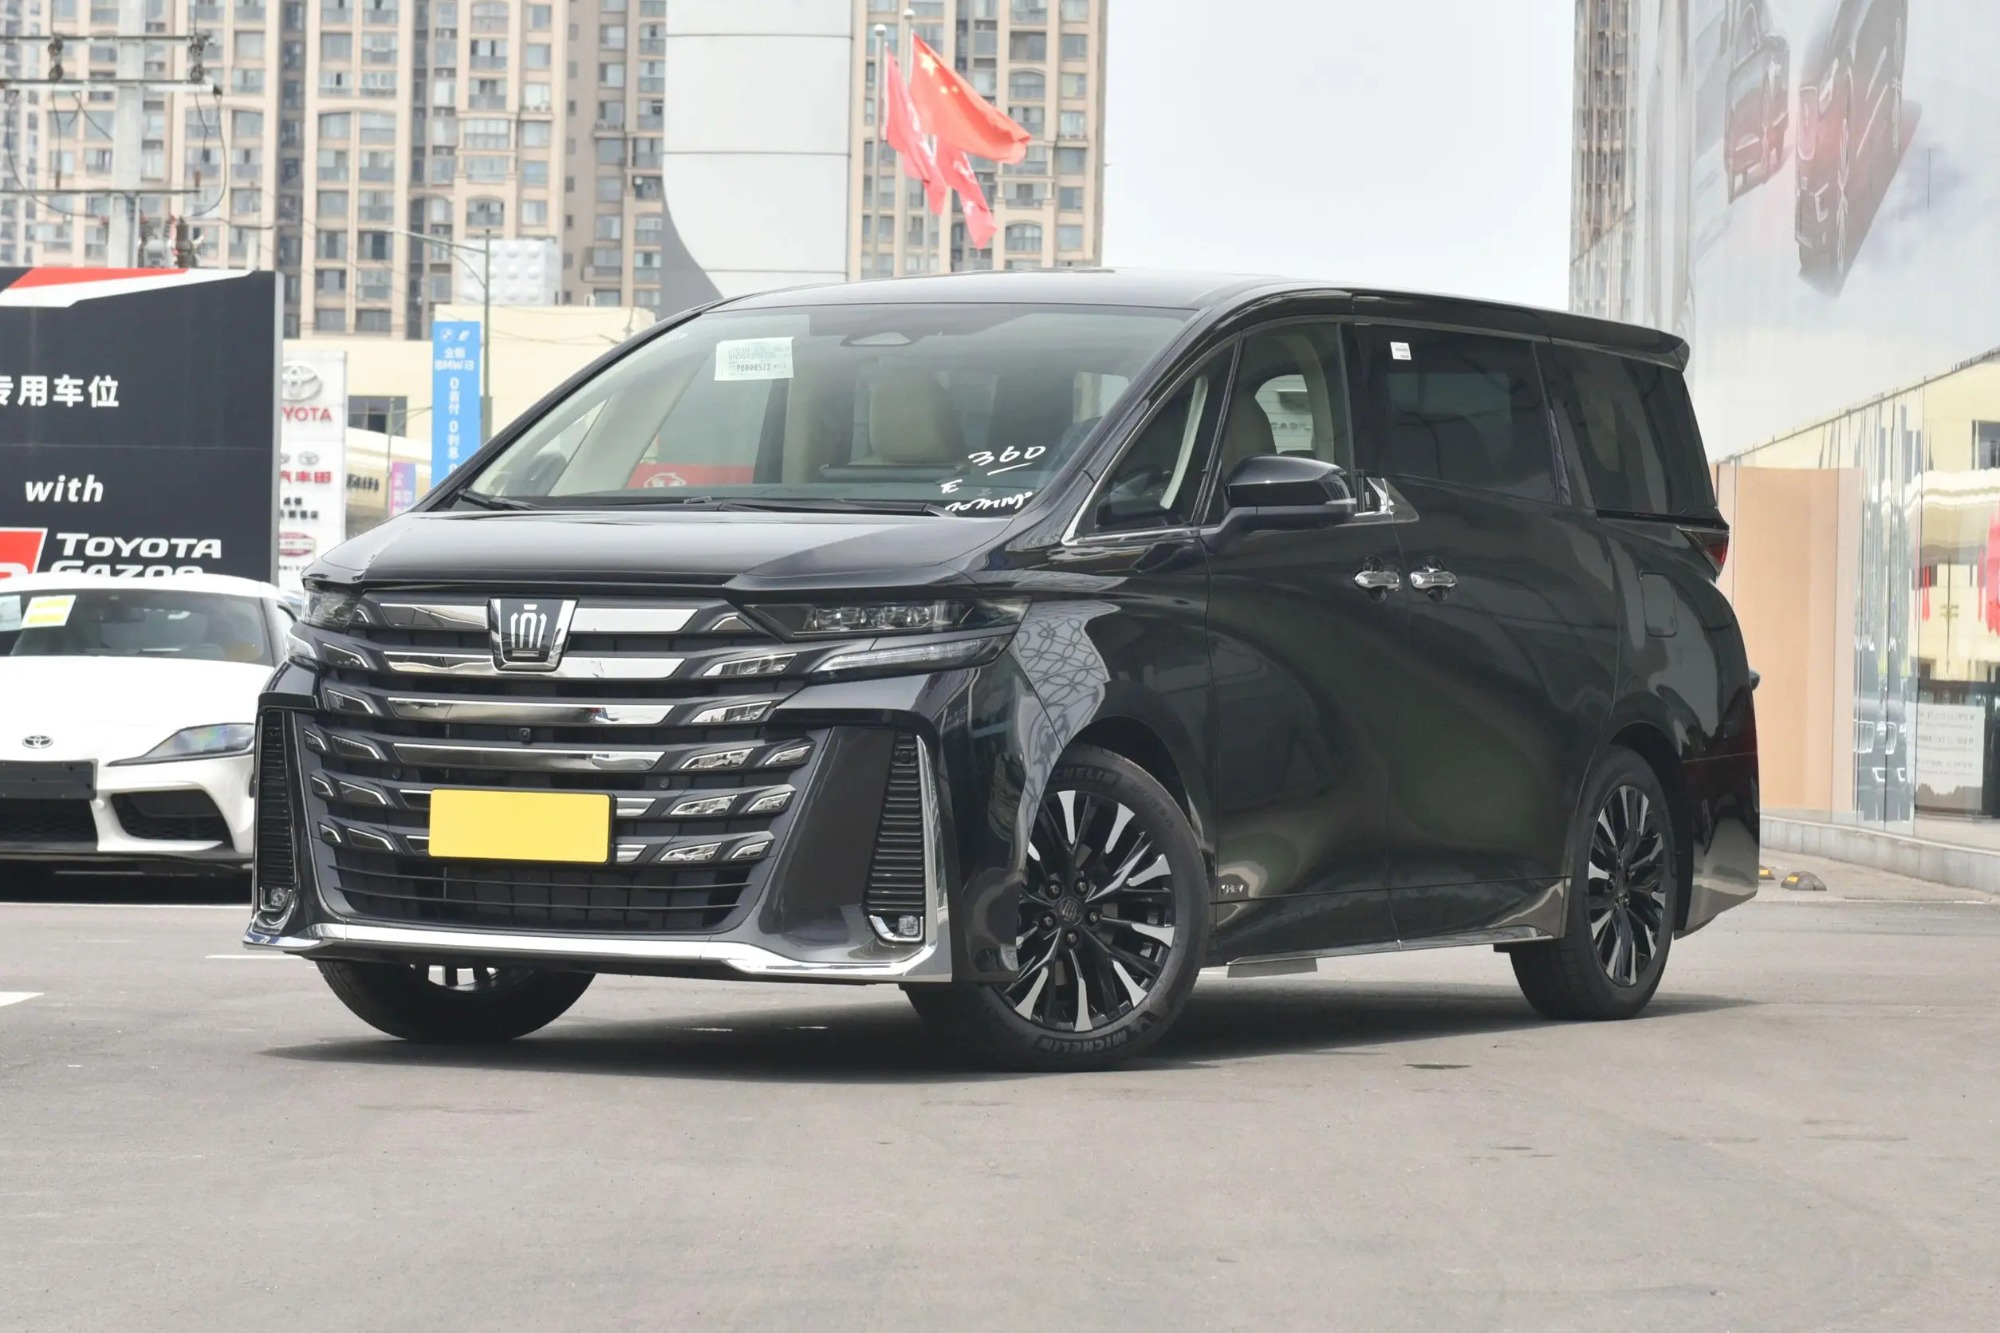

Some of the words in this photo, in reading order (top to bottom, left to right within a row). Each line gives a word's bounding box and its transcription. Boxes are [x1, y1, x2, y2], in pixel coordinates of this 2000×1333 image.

[281, 405, 333, 422] YOTA
[967, 445, 1047, 467] 360
[25, 474, 104, 503] with
[56, 532, 222, 559] TOYOTA
[1039, 1030, 1128, 1053] MICHELIN
